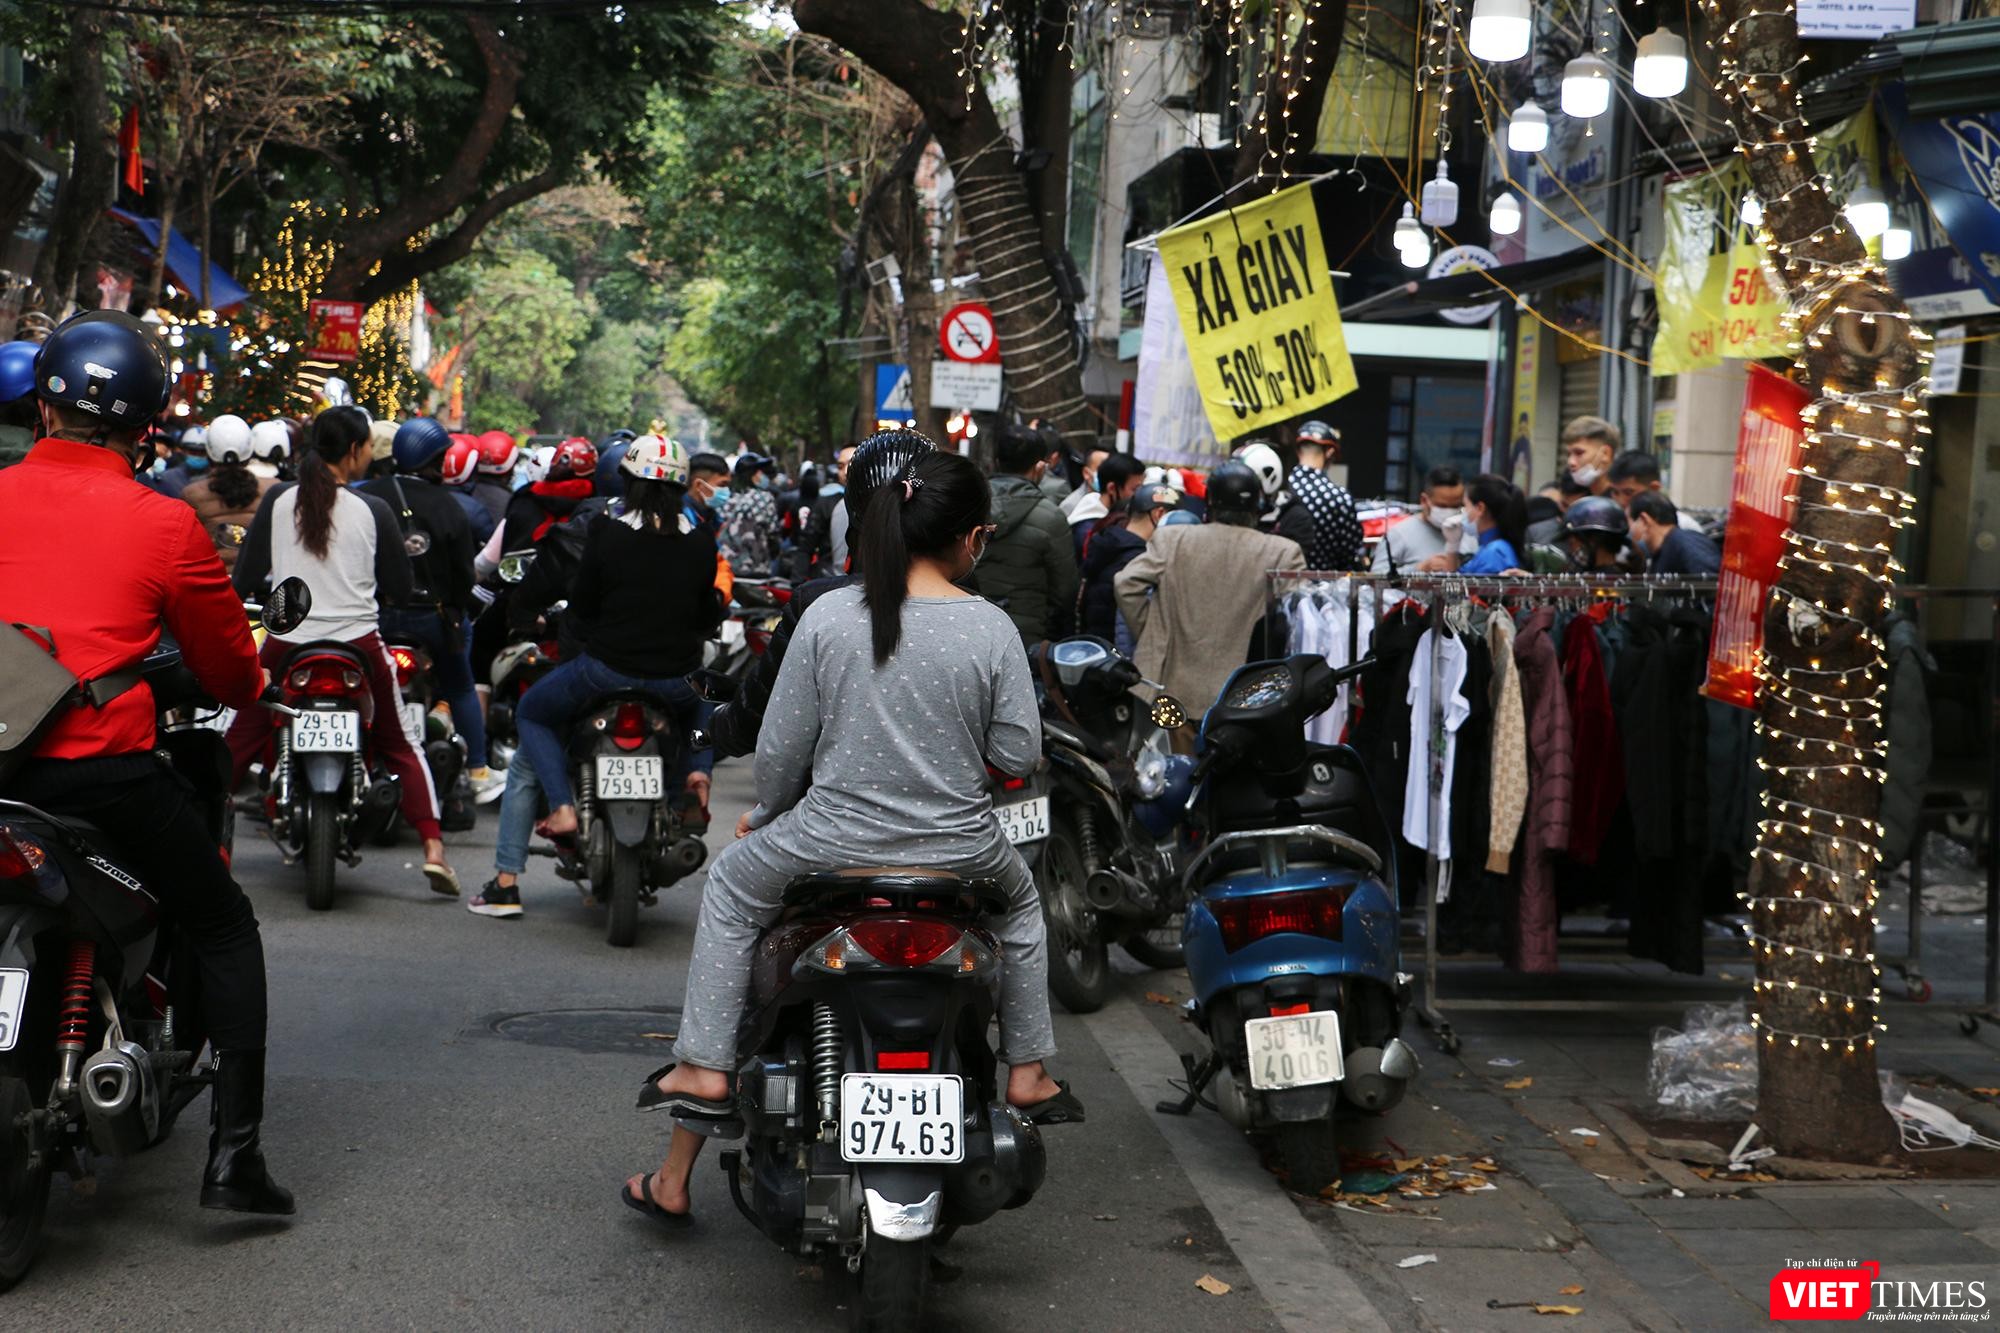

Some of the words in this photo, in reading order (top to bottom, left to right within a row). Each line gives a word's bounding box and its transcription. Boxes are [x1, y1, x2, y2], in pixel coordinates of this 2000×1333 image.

[1182, 231, 1238, 334] XẢ
[303, 713, 347, 729] 29-C1
[297, 731, 353, 747] 675.84
[607, 758, 652, 776] 29-E1
[602, 778, 658, 795] 759.13
[1268, 963, 1308, 973] HONDA
[1265, 1050, 1329, 1082] 4006
[861, 1081, 941, 1115] 29-B1
[851, 1121, 954, 1155] 974.63
